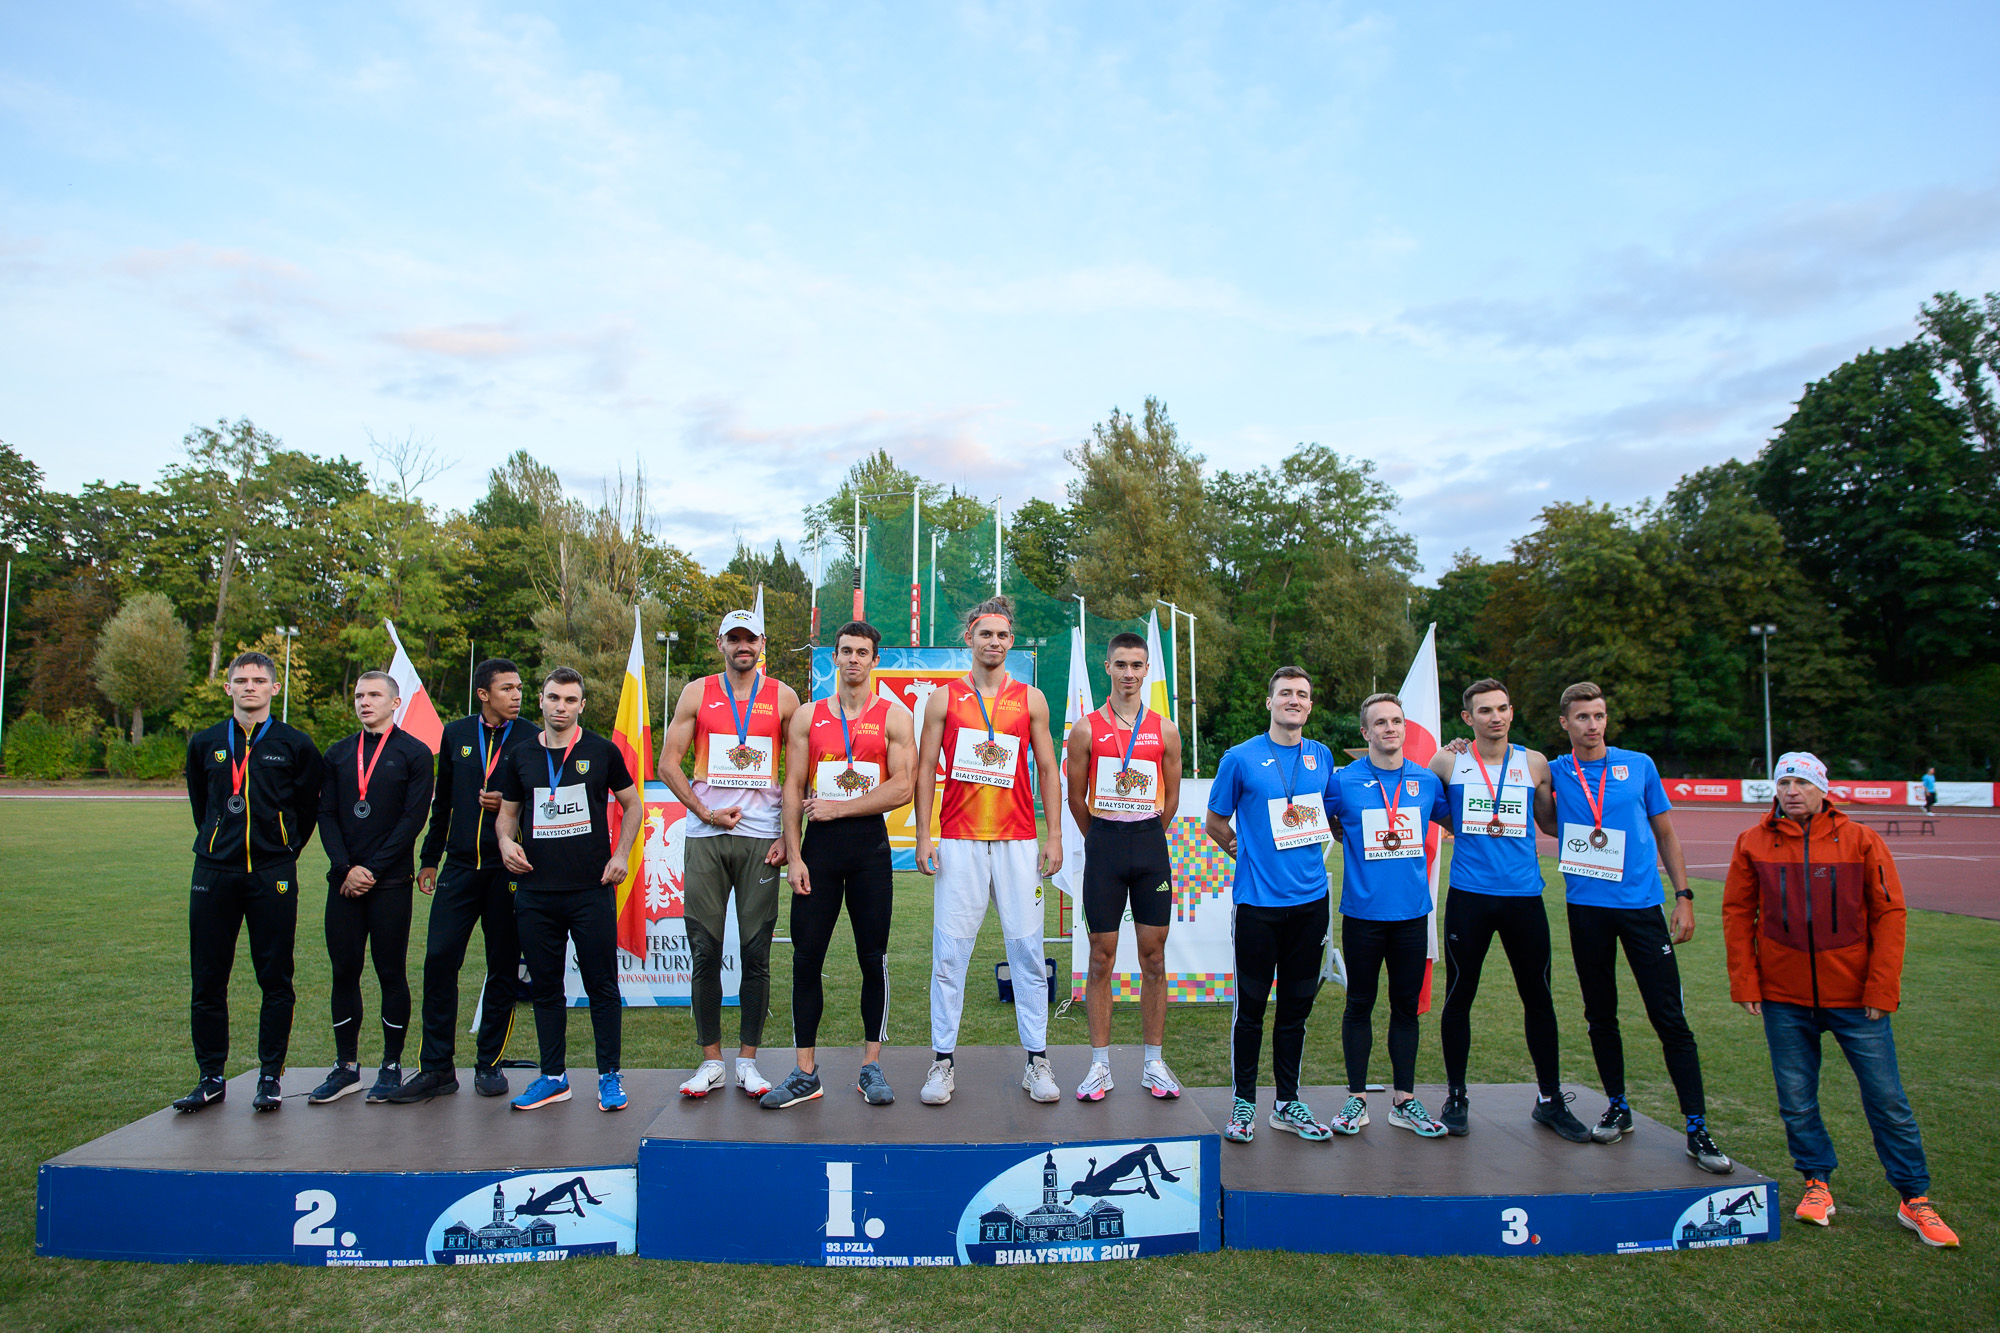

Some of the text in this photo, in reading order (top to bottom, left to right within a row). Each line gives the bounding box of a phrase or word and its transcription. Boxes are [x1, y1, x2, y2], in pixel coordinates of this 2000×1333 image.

[955, 772, 992, 783] BIAŁYSTOK
[994, 778, 1010, 786] 2022
[1098, 801, 1135, 809] BIAŁYSTOK
[536, 825, 588, 837] BIAŁYSTOK 2022
[1377, 830, 1411, 840] OEN
[1279, 837, 1313, 847] BIAŁYSTOK
[1313, 833, 1330, 841] 2022
[1368, 850, 1404, 858] BIAŁYSTOK
[1562, 865, 1599, 876] BIAŁYSTOK
[826, 1162, 885, 1239] 1.
[293, 1189, 357, 1248] 2.
[1688, 1237, 1749, 1249] BIAŁYSTOK 2017
[455, 1250, 569, 1265] BIAŁYSTOK 2017
[995, 1243, 1140, 1265] BIAŁYSTOK 2017
[392, 1259, 424, 1267] POLSKI
[826, 1256, 954, 1266] MISTRZOSTWA POLSKI
